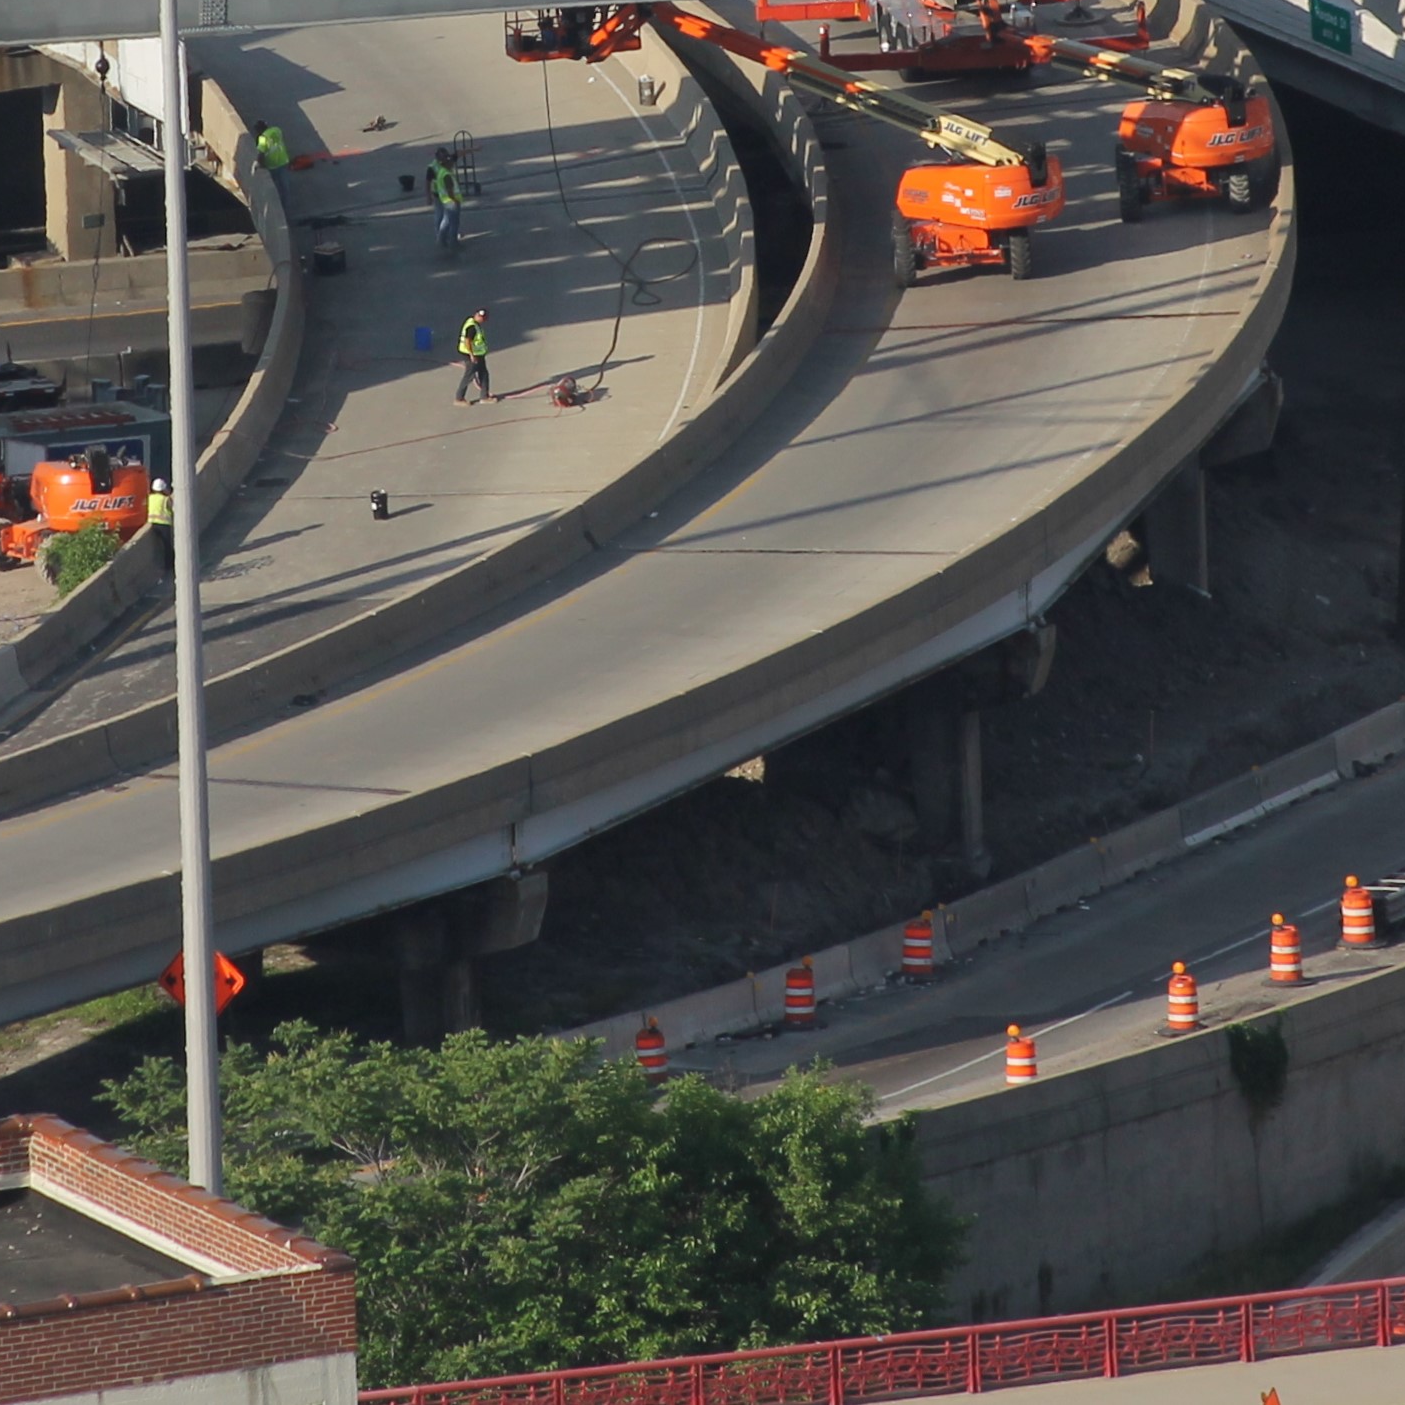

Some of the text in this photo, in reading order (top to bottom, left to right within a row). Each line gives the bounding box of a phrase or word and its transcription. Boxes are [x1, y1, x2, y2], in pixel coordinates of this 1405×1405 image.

[944, 122, 988, 146] JLG LIFT
[1208, 126, 1264, 146] JLG LIFT
[1013, 194, 1040, 209] JLG
[71, 496, 134, 512] JLG LIFT
